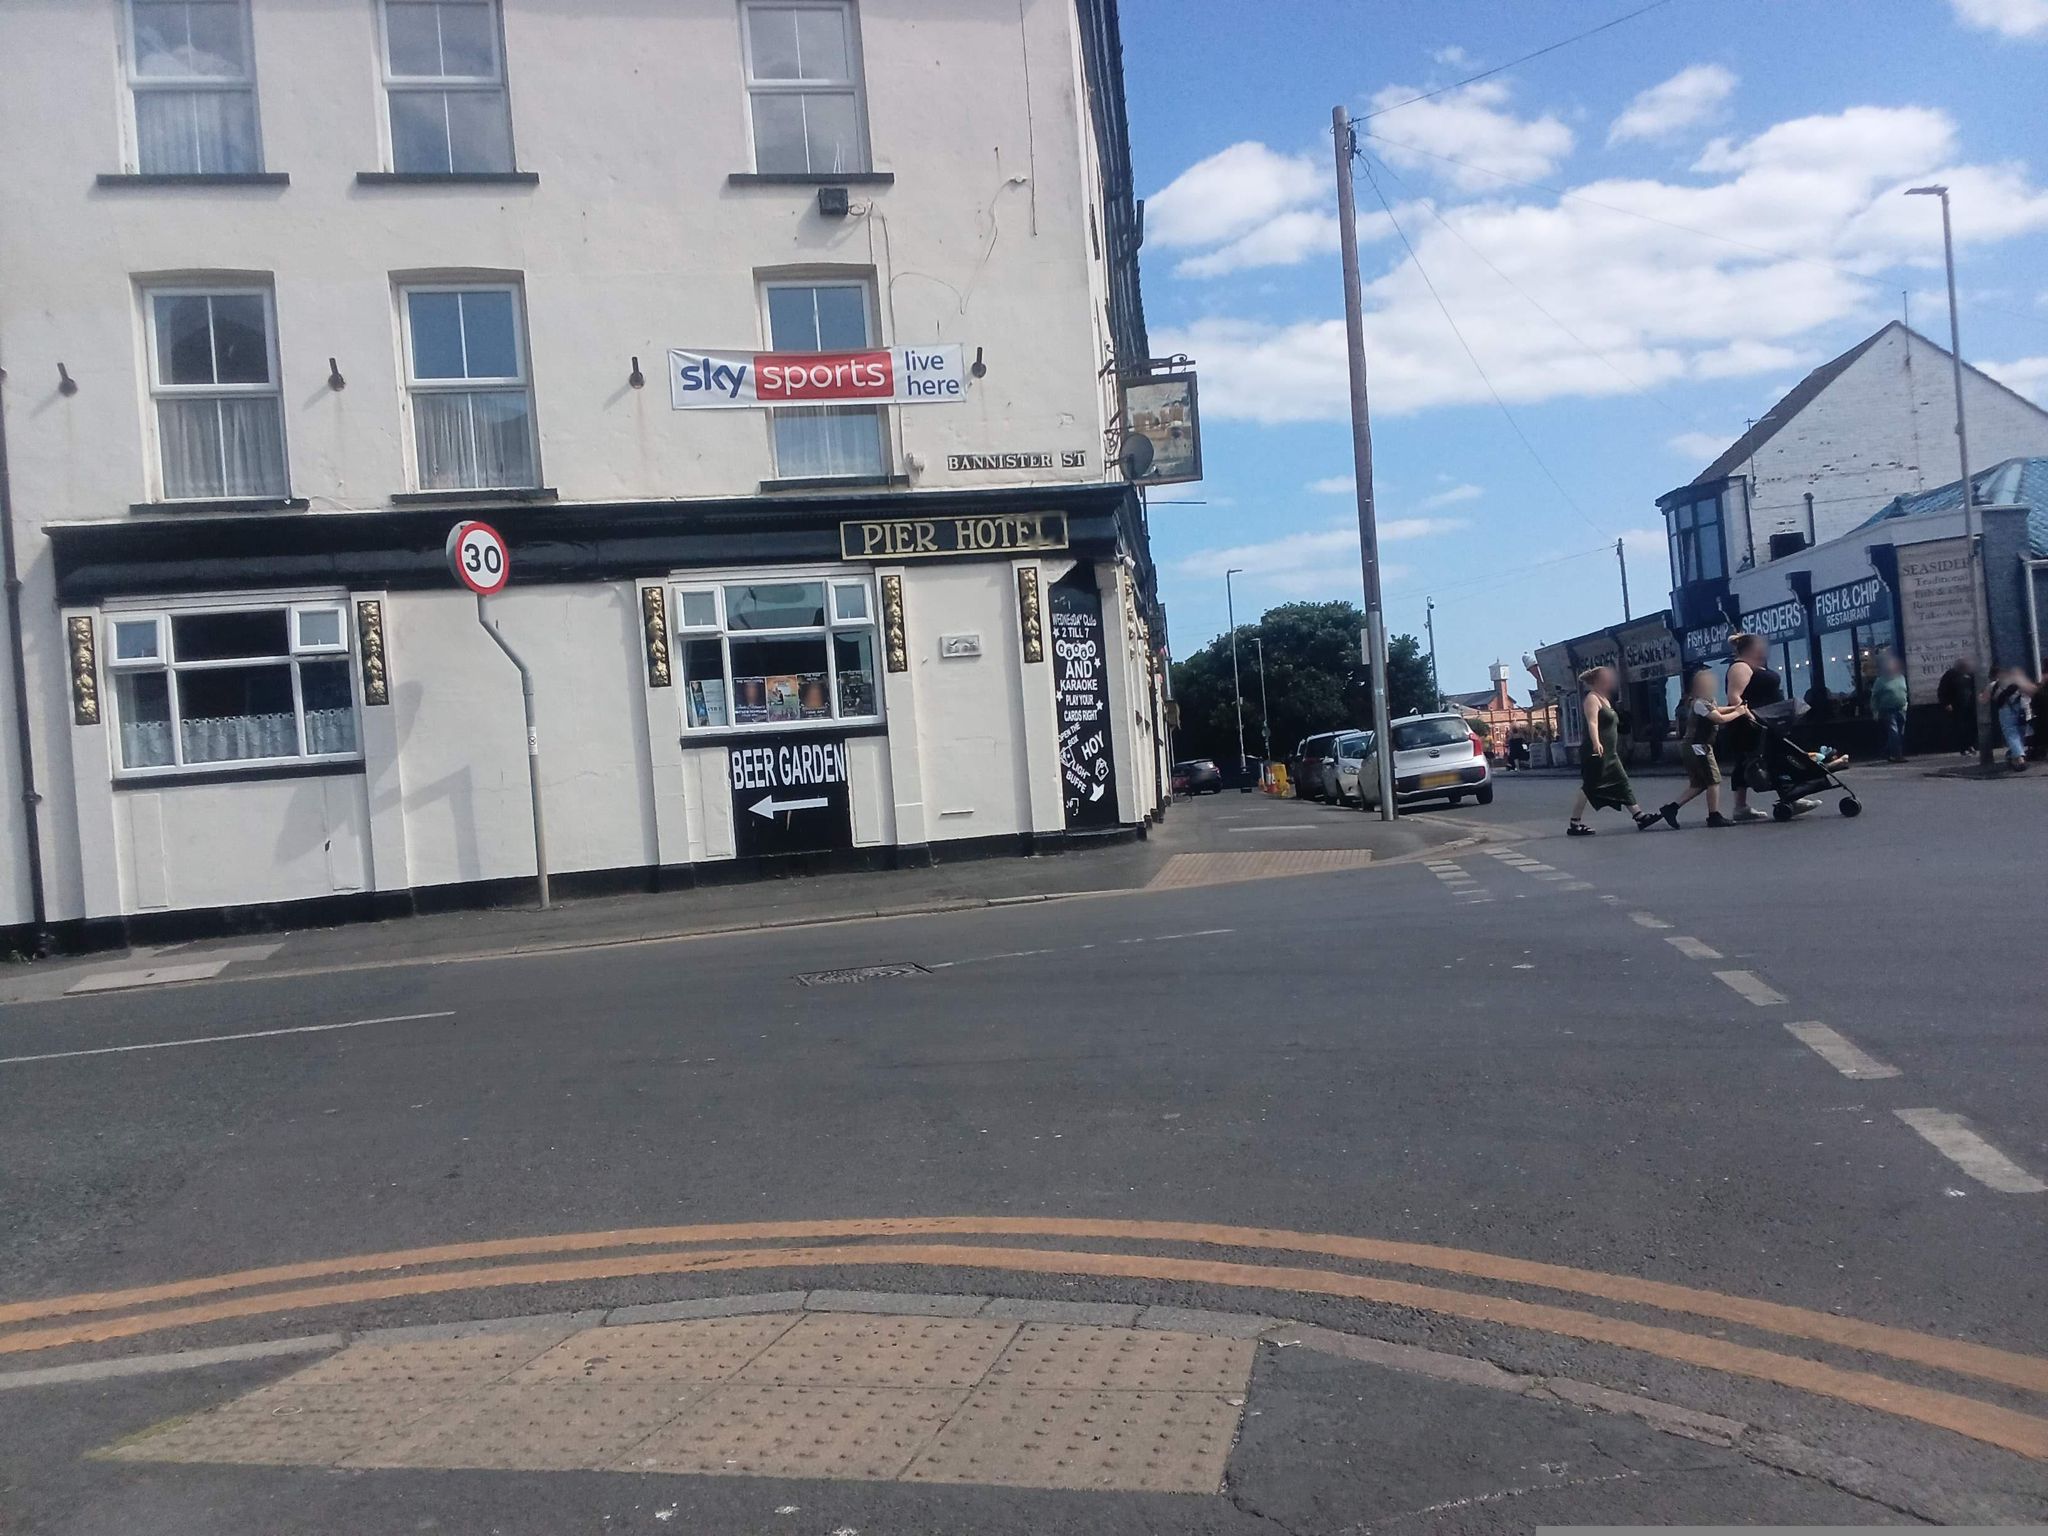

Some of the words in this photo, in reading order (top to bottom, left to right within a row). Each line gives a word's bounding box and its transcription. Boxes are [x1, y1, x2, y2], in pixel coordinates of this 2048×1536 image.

[904, 350, 944, 373] live
[681, 357, 747, 398] sky
[762, 359, 887, 396] sports
[906, 375, 960, 396] here
[948, 453, 1052, 470] BANNISTER
[1062, 451, 1085, 467] ST
[861, 522, 938, 554] PIER
[464, 543, 501, 574] 30
[1816, 590, 1841, 616] FISH
[1842, 588, 1850, 609] &
[1852, 579, 1880, 605] CHIP
[1741, 602, 1802, 635] SEASIDERS
[1826, 605, 1870, 627] RESTAURANT
[1062, 628, 1067, 637] 2
[1069, 628, 1083, 638] TILL
[1085, 628, 1090, 638] 7
[1687, 628, 1702, 649] FISH
[1711, 622, 1729, 643] CHIP
[1066, 660, 1093, 679] AND
[1060, 679, 1098, 691] KARAOKE
[1066, 694, 1079, 706] PLAY
[1079, 694, 1094, 705] YOUR
[1064, 710, 1082, 722] CARDS
[1083, 709, 1098, 721] RIGHT
[1058, 729, 1071, 743] OPEN
[1070, 722, 1081, 733] THE
[1081, 730, 1104, 761] HOY
[732, 746, 779, 790] BEER
[778, 743, 846, 787] GARDEN
